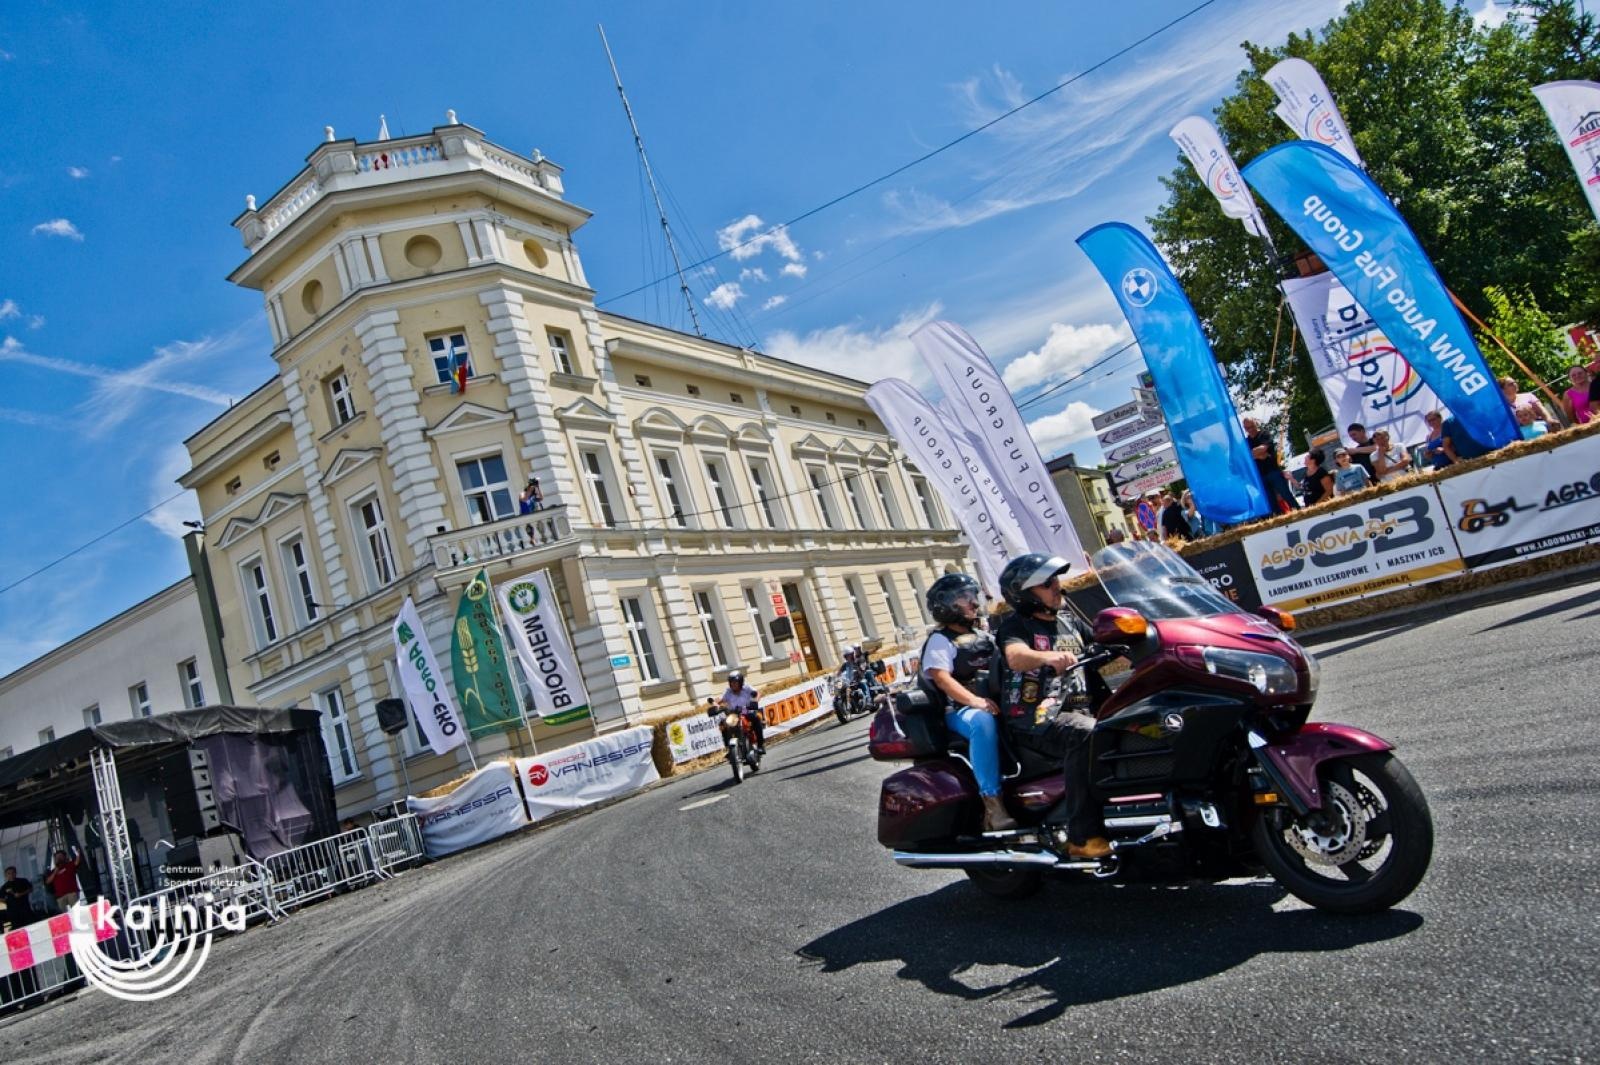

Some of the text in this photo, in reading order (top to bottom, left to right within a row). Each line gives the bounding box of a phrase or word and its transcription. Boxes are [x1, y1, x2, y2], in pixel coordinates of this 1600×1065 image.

[1135, 455, 1164, 472] Policja
[1261, 496, 1435, 581] JCB
[1261, 529, 1361, 568] AGRONOVA
[1268, 580, 1313, 597] ŁADOWARKI
[1315, 564, 1369, 586] TELESKOPOWE
[1387, 552, 1427, 568] MASZYNY
[1429, 546, 1445, 558] JCB
[522, 614, 573, 709] BIOCHEM
[427, 785, 512, 826] VANESSA
